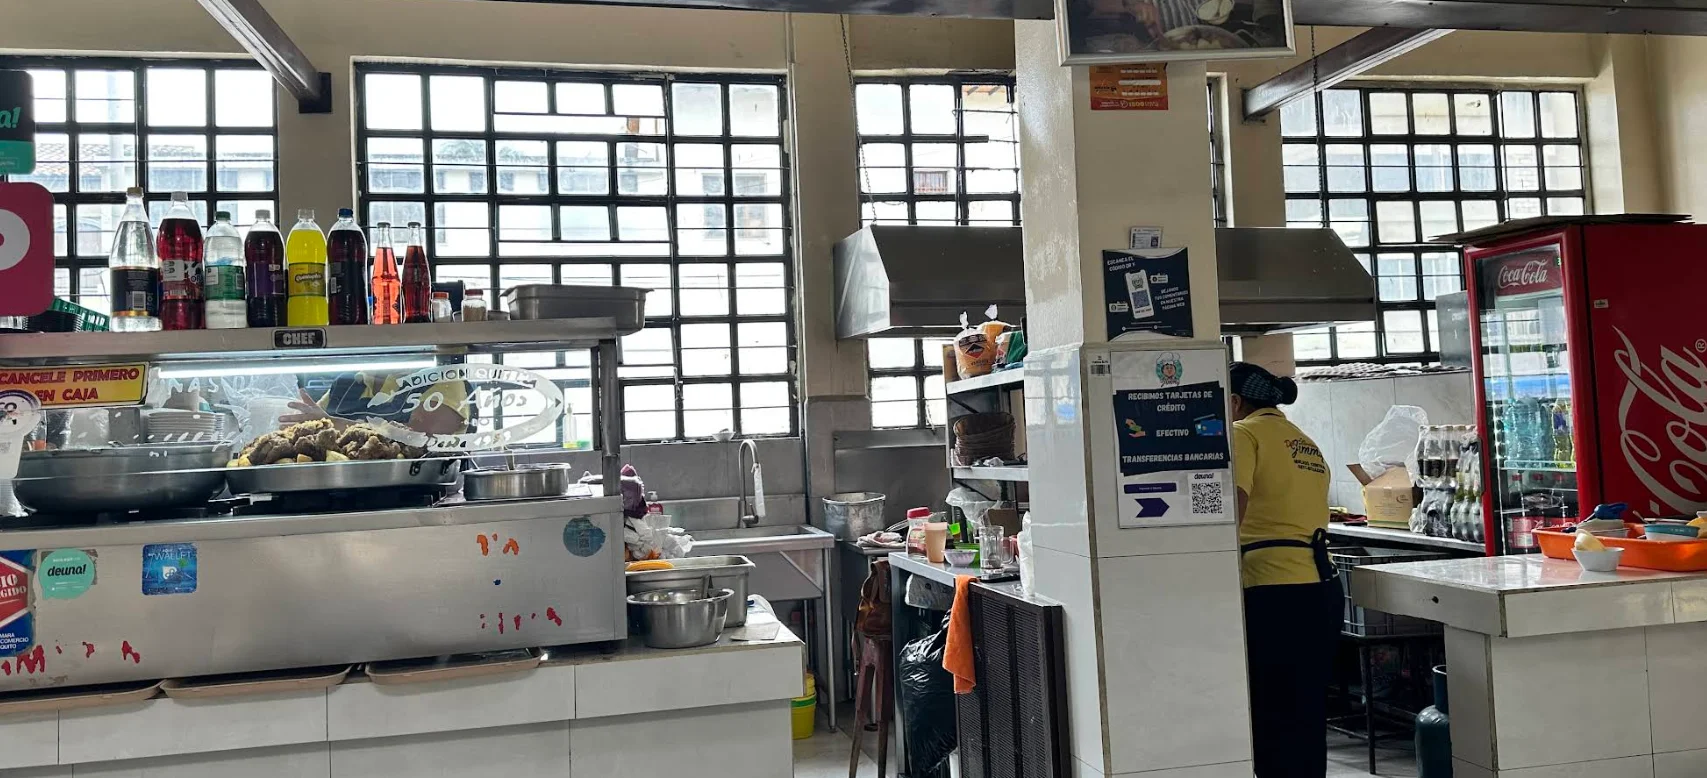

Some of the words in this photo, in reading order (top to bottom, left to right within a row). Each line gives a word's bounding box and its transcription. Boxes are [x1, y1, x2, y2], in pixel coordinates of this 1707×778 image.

[1498, 259, 1549, 289] Coca-Cola
[282, 331, 316, 345] CHEF
[0, 371, 66, 385] CANCELE
[73, 368, 140, 383] PRIMERO
[35, 389, 55, 401] EN
[62, 388, 98, 401] CAJA
[1128, 392, 1164, 401] RECIBIMOS
[1165, 391, 1202, 400] TARJETAS
[1203, 391, 1213, 399] DE
[402, 391, 444, 413] 50
[1157, 403, 1186, 412] CRÉDITO
[1155, 429, 1189, 438] EFECTIVO
[1122, 454, 1183, 464] TRANSFERENCIAS
[1184, 452, 1224, 462] BANCARIAS
[47, 564, 87, 577] deuna!
